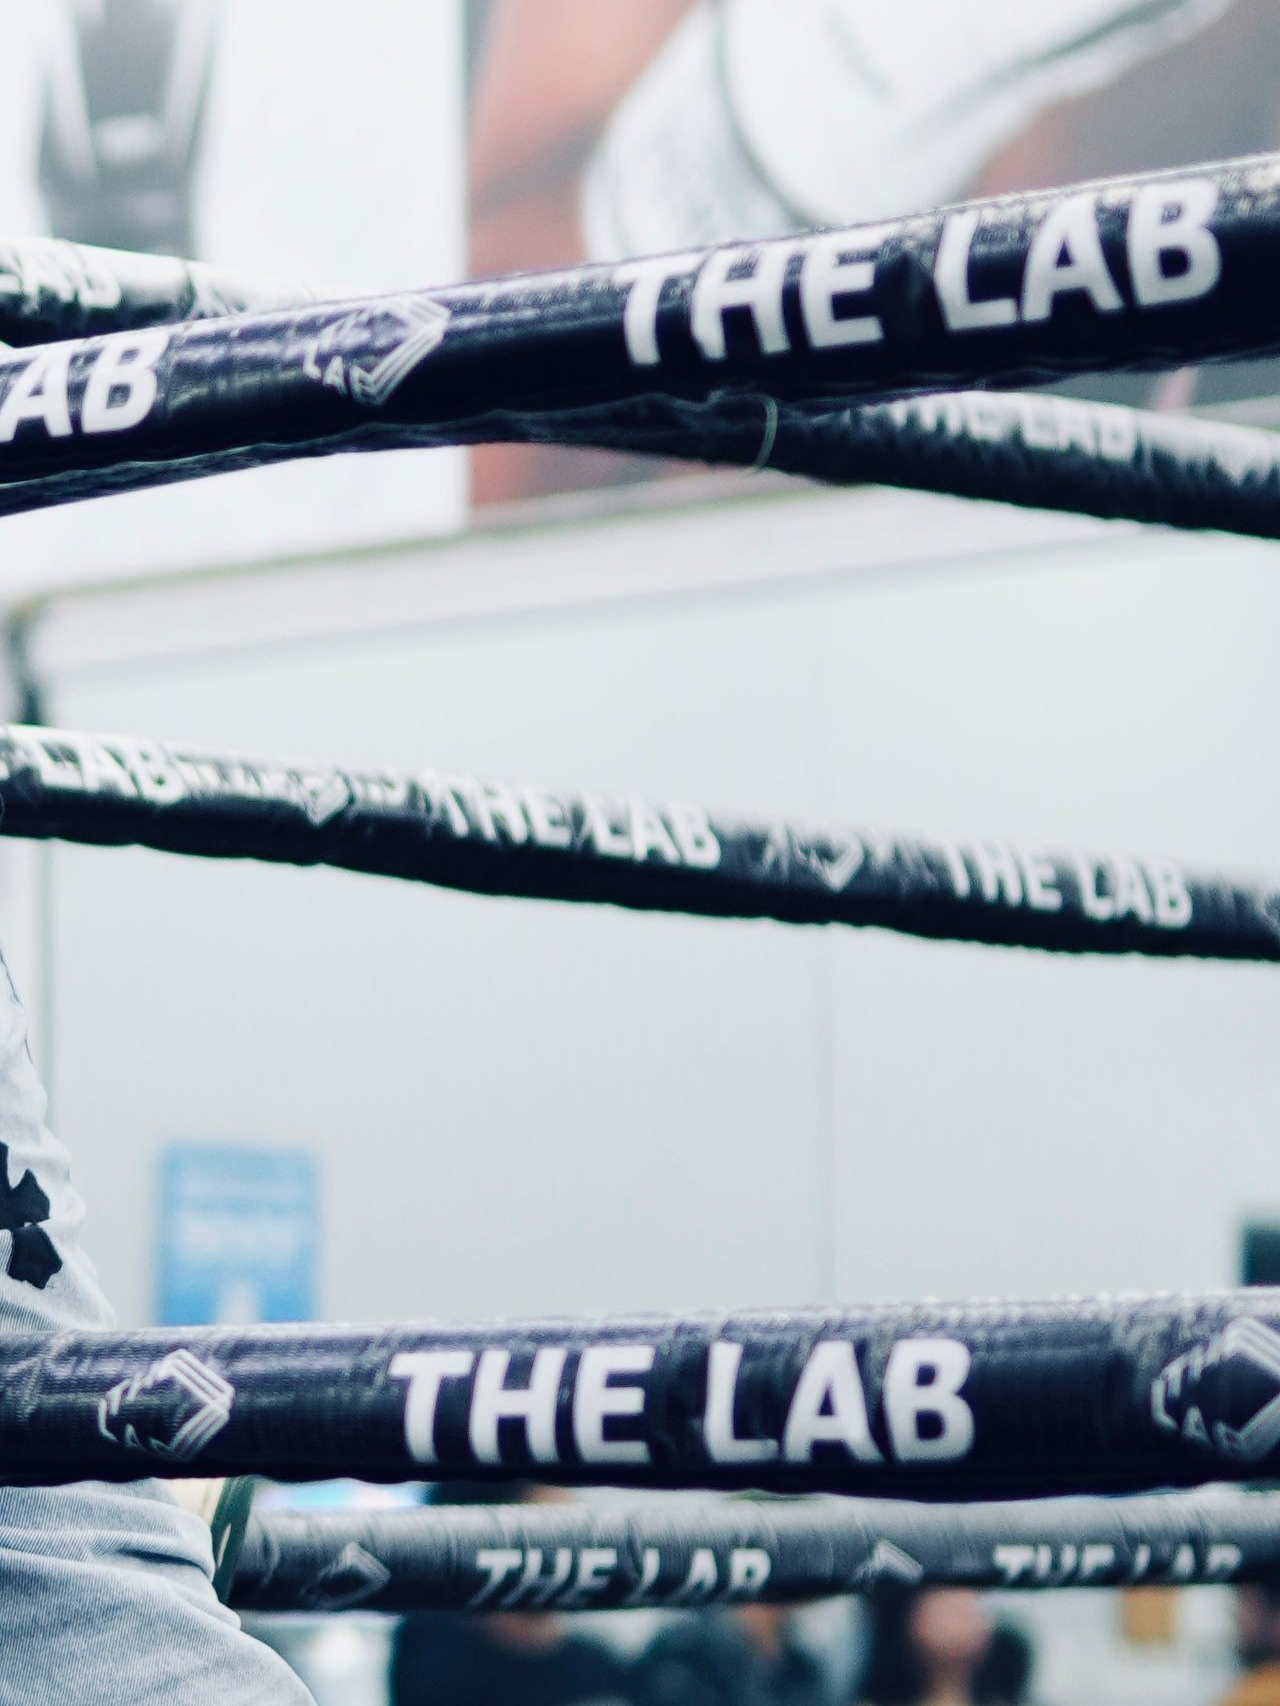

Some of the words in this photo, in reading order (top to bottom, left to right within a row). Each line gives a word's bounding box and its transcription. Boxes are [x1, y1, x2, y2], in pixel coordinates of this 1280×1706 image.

[616, 221, 902, 367] THE
[934, 179, 1222, 332] LAB
[37, 727, 182, 804] LAB
[420, 771, 573, 849] THE
[590, 791, 721, 870] LAB
[937, 835, 1062, 912] THE
[1076, 843, 1192, 928] LAB
[389, 1344, 656, 1466] THE
[706, 1337, 974, 1465] LAB
[470, 1546, 619, 1609] THE
